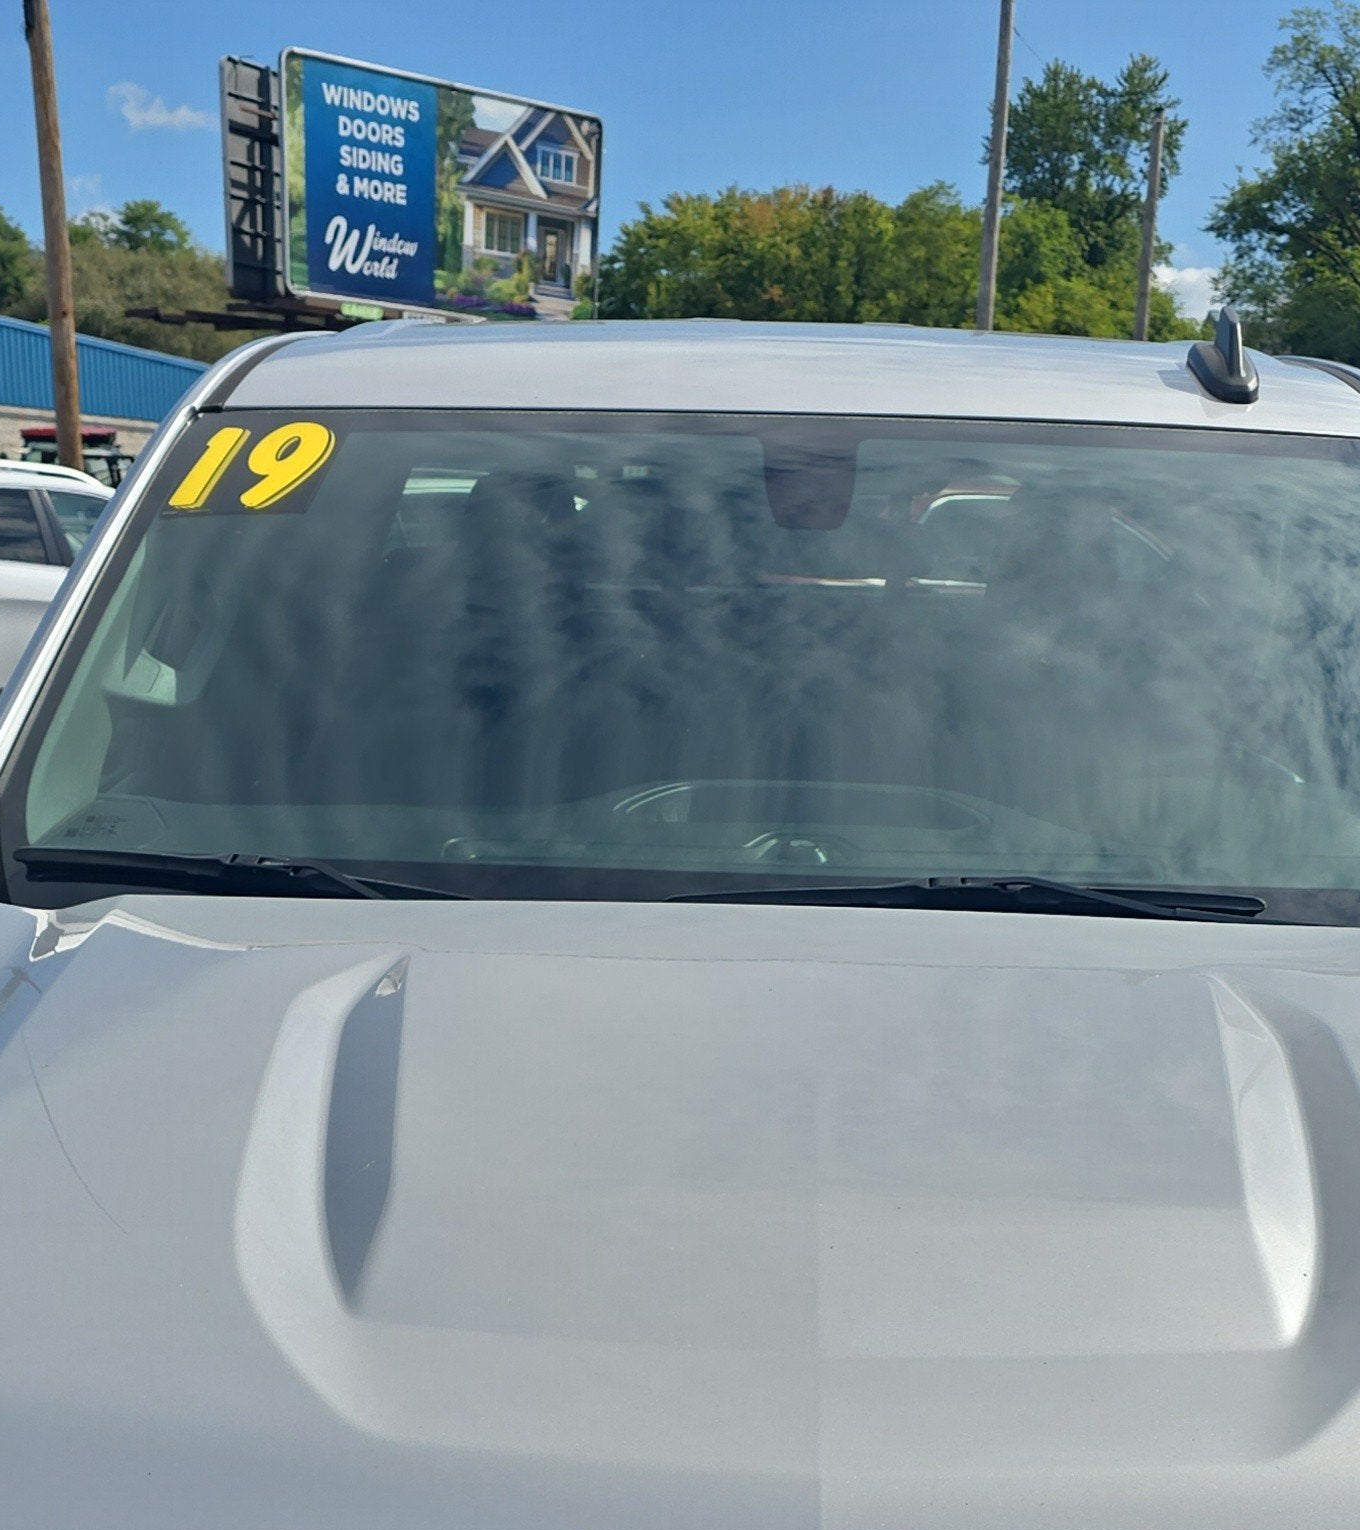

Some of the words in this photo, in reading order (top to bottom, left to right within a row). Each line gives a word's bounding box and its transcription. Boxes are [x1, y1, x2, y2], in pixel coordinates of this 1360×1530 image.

[322, 82, 420, 122] WINDOWS
[338, 115, 405, 148] DOORS
[339, 144, 404, 176] SIDING
[336, 173, 350, 196] &
[353, 176, 408, 206] MORE
[168, 421, 336, 510] 19
